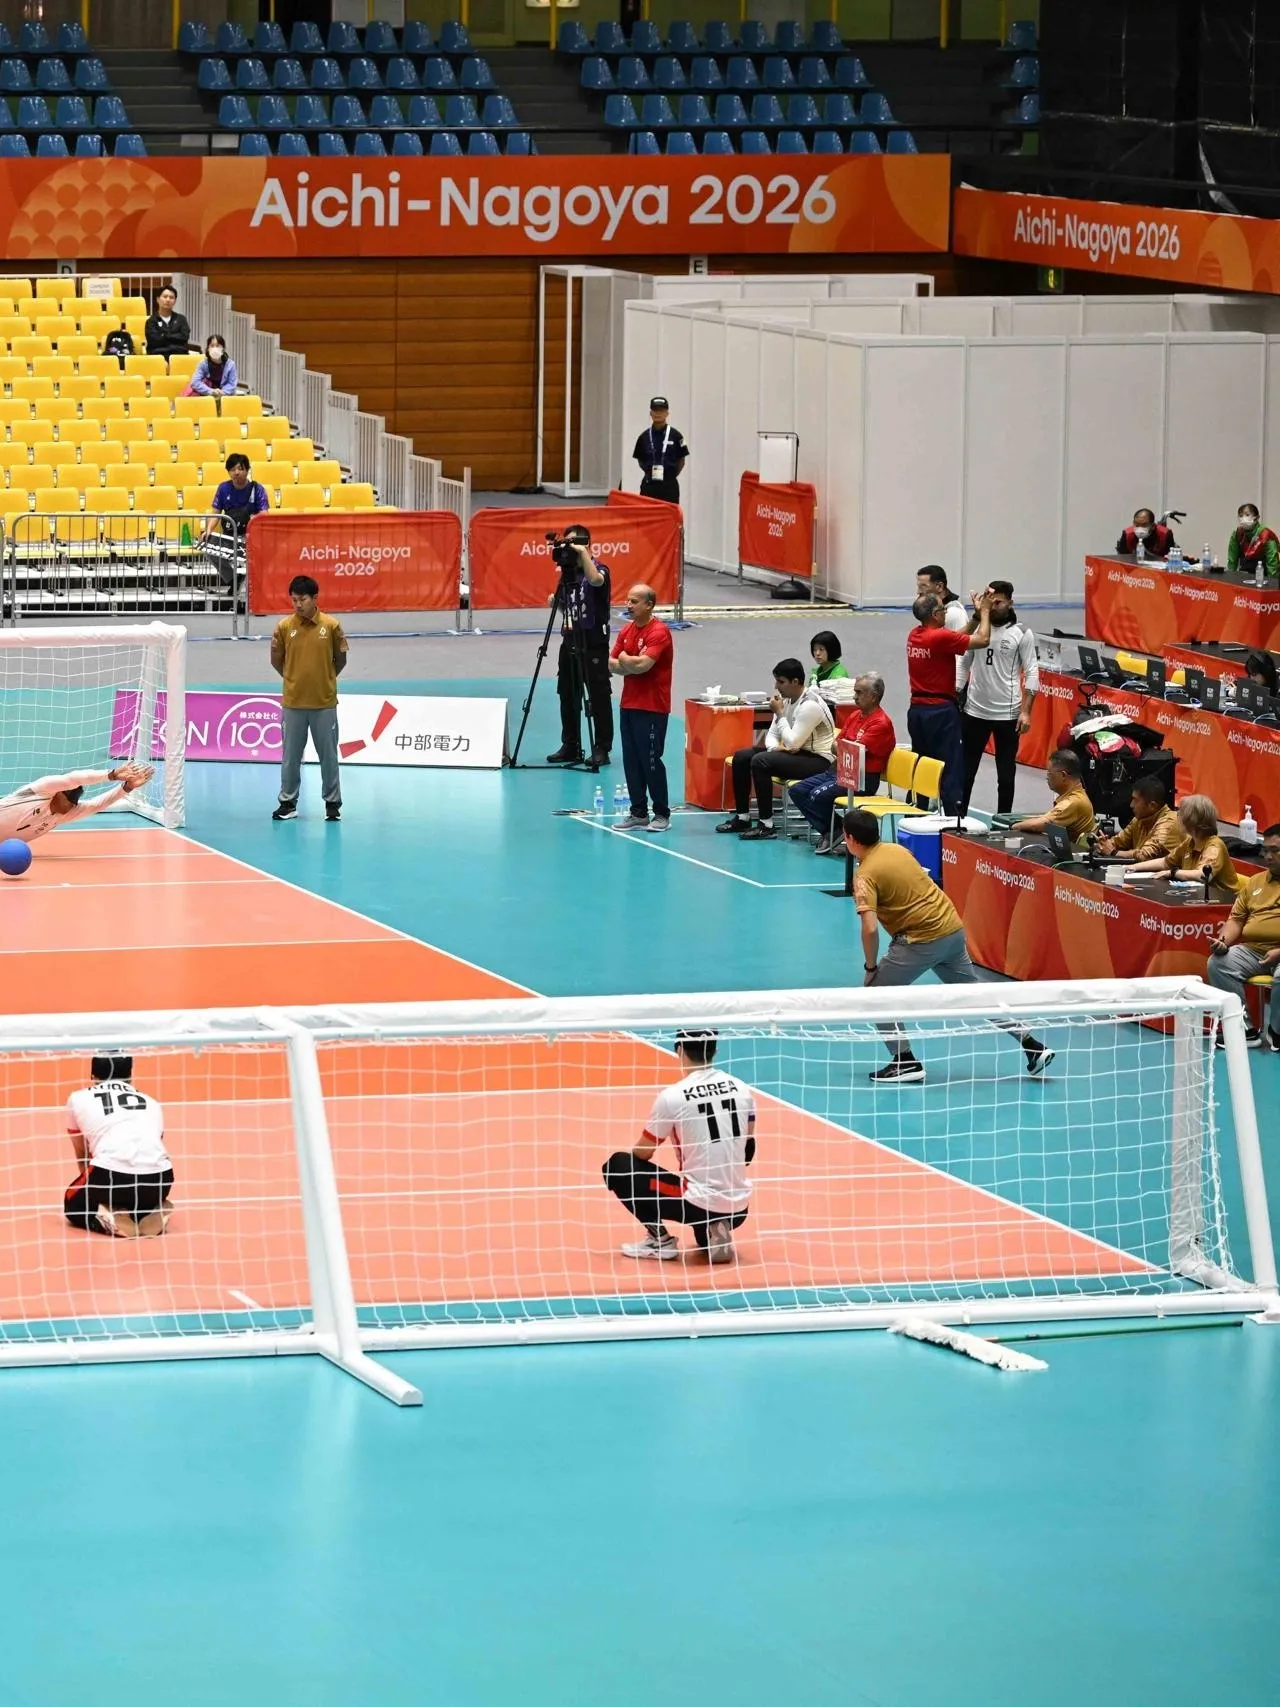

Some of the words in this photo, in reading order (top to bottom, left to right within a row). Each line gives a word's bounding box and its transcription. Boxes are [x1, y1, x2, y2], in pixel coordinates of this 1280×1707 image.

[249, 171, 668, 242] Aichi-Nagoya
[688, 174, 837, 225] 2026
[1014, 205, 1131, 265] Aichi-Nagoya
[1135, 220, 1180, 261] 2026
[693, 259, 704, 274] E
[756, 503, 796, 526] Aichi-Nagoya
[768, 522, 784, 537] 2026
[299, 544, 411, 563] Aichi-Nagoya
[334, 562, 376, 577] 2026
[985, 648, 994, 666] 8
[1058, 686, 1074, 701] 2026
[1122, 704, 1140, 718] 2026
[1156, 711, 1196, 735] Aichi-Nagoya
[230, 721, 283, 749] 100
[394, 733, 470, 752] 中部電力
[1227, 730, 1268, 754] Aichi-Nagoya
[842, 751, 854, 770] IRI
[942, 848, 957, 865] 2026
[975, 858, 1019, 888] Aichi-Nagoya
[1018, 876, 1036, 891] 2026
[1054, 884, 1102, 916] Aichi-Nagoya
[1101, 902, 1119, 919] 2026
[1140, 912, 1214, 940] Aichi-Nagoya
[683, 1080, 739, 1101] KOREA
[94, 1091, 147, 1116] 10
[697, 1097, 741, 1143] 11
